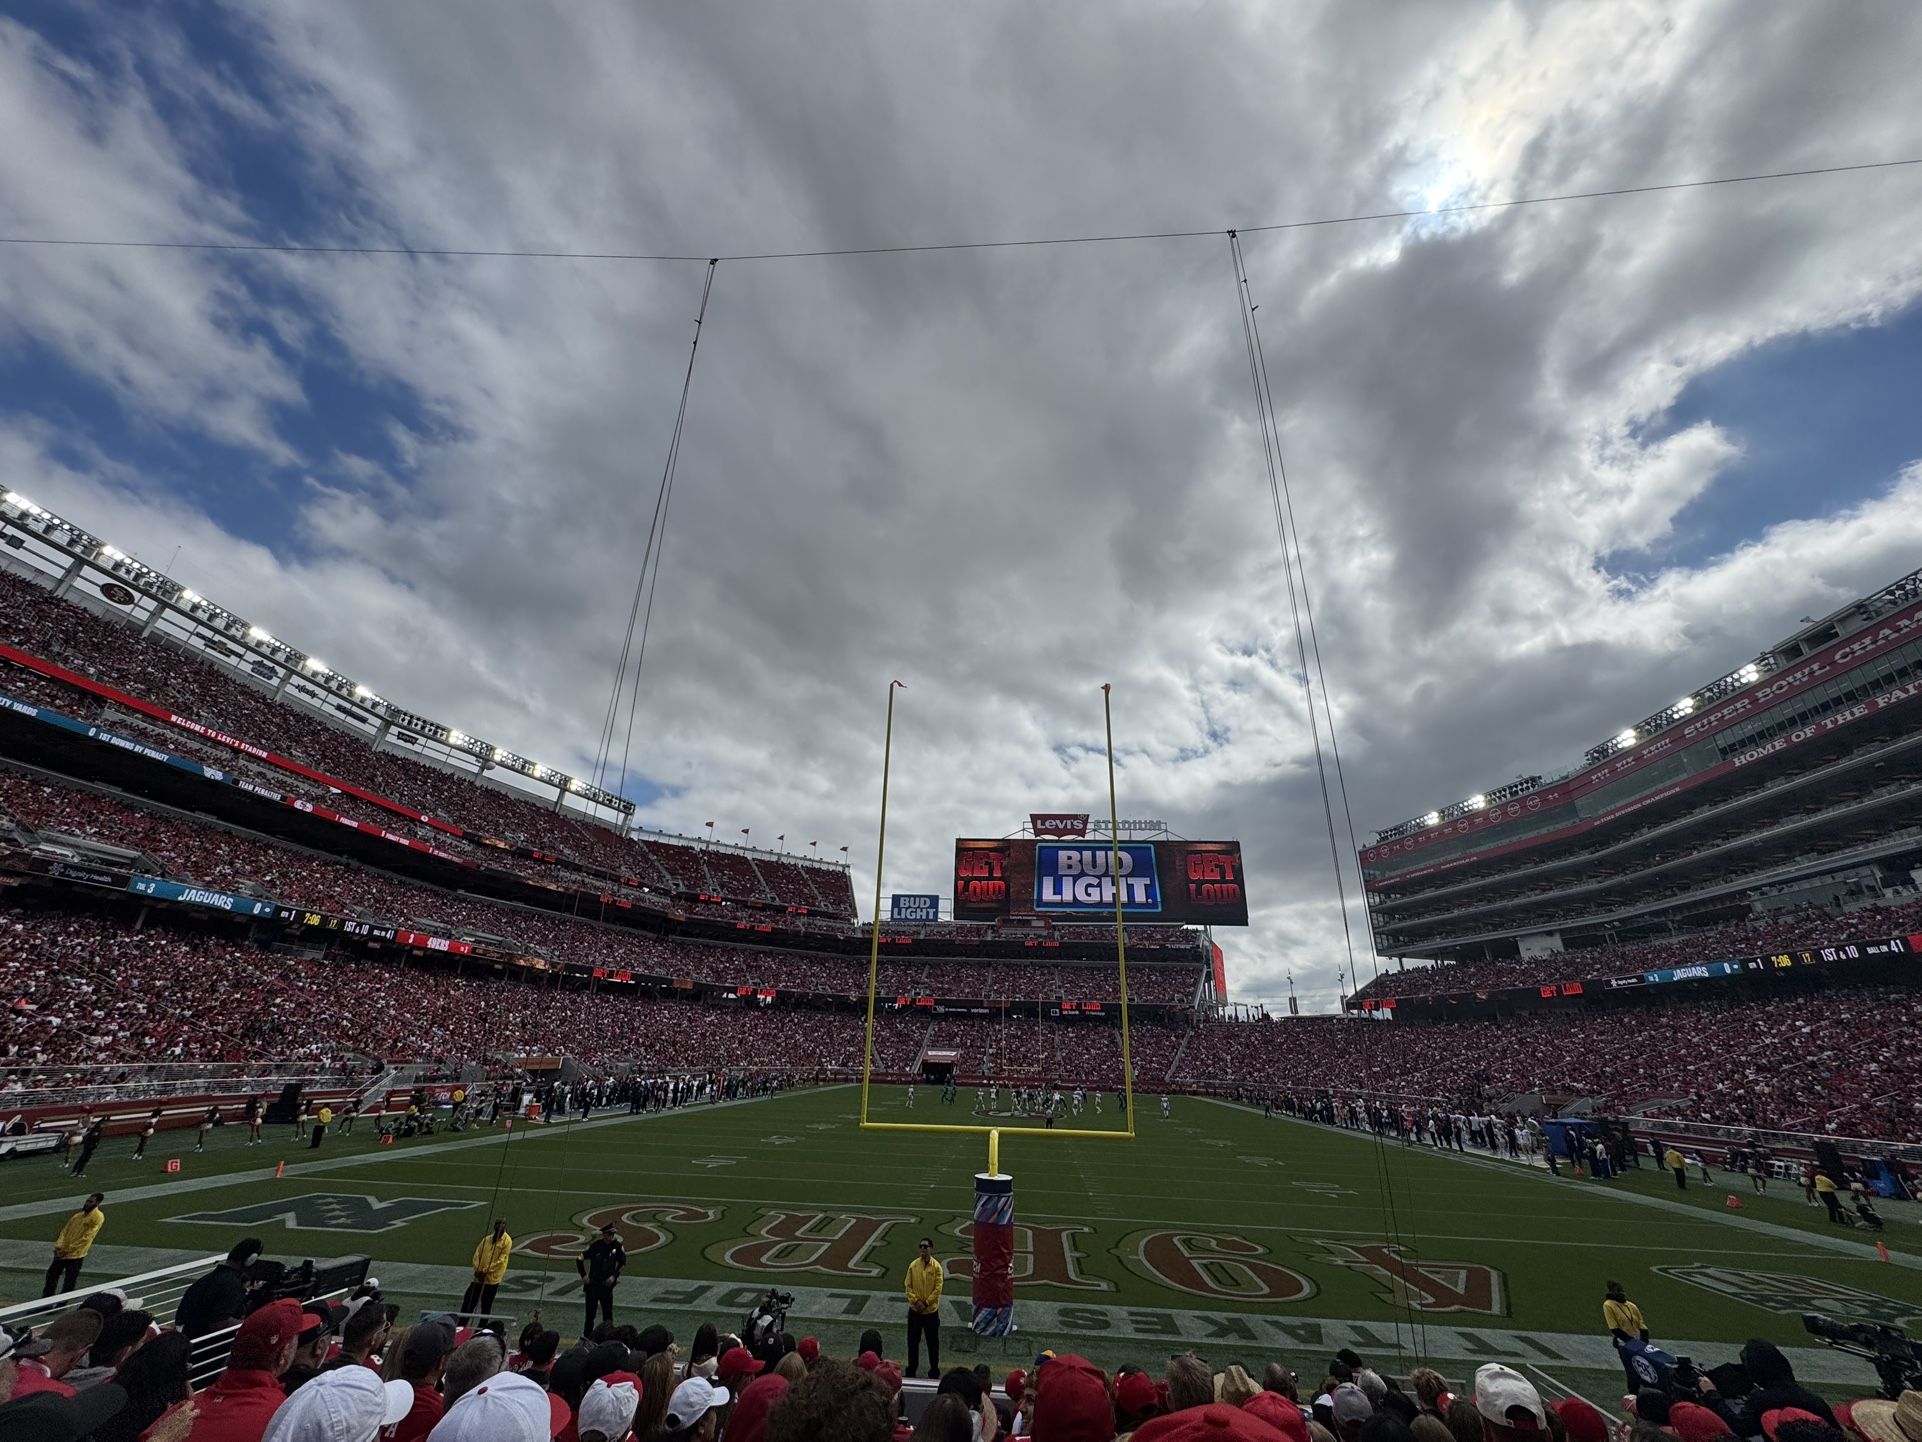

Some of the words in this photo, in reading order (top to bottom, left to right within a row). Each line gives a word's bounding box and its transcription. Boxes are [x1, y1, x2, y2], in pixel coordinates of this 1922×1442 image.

[13, 702, 38, 717] YARDS
[1684, 699, 1753, 738] SUPER
[1755, 663, 1830, 703] BOWL
[88, 727, 96, 737] 0
[99, 733, 111, 742] 1ST
[111, 735, 135, 750] DOWNS
[134, 744, 147, 753] BY
[144, 745, 170, 762] PENALTY
[171, 714, 205, 734] WELCOME
[207, 729, 217, 738] TO
[217, 733, 240, 747] LEVI'S
[240, 742, 269, 758] STADIUM
[1733, 738, 1787, 768] HOME
[1791, 725, 1817, 742] OF
[1821, 704, 1868, 731] THE
[238, 780, 254, 792] TEAM
[254, 786, 282, 800] PENALTIES
[1642, 786, 1681, 805] CHAMPIONS
[1093, 819, 1162, 831] STADIUM
[958, 851, 1004, 877] GET
[1058, 849, 1134, 876] BUD
[1186, 852, 1237, 880] GET
[65, 867, 91, 880] Dignity
[90, 873, 112, 883] Health
[147, 883, 155, 894] 3
[178, 889, 234, 910] JAGUARS
[253, 902, 262, 915] 0
[957, 880, 1006, 901] LOUD
[1188, 883, 1241, 906] LOUD
[893, 908, 936, 919] LIGHT
[900, 897, 930, 908] BUD
[290, 910, 297, 921] 1
[303, 912, 321, 926] 7:06
[328, 919, 338, 928] 17
[343, 920, 357, 932] 1ST
[360, 924, 370, 935] 10
[386, 929, 395, 940] 41
[408, 933, 415, 944] 3
[426, 936, 450, 952] 49ERS
[1757, 958, 1764, 970] 1
[1771, 954, 1792, 968] 7:06
[1801, 953, 1812, 963] 17
[1820, 948, 1838, 962] 1ST
[1839, 950, 1847, 960] &
[1845, 945, 1859, 959] 10
[1890, 939, 1904, 953] 41
[1672, 966, 1709, 981] JAGUARS
[1723, 962, 1731, 974] 0
[1082, 1002, 1101, 1011] LOUD
[170, 1160, 179, 1171] G
[511, 1203, 1511, 1318] 49ERS
[650, 1285, 773, 1308] OF
[1057, 1307, 1407, 1350] TAKES
[1454, 1331, 1570, 1361] IT
